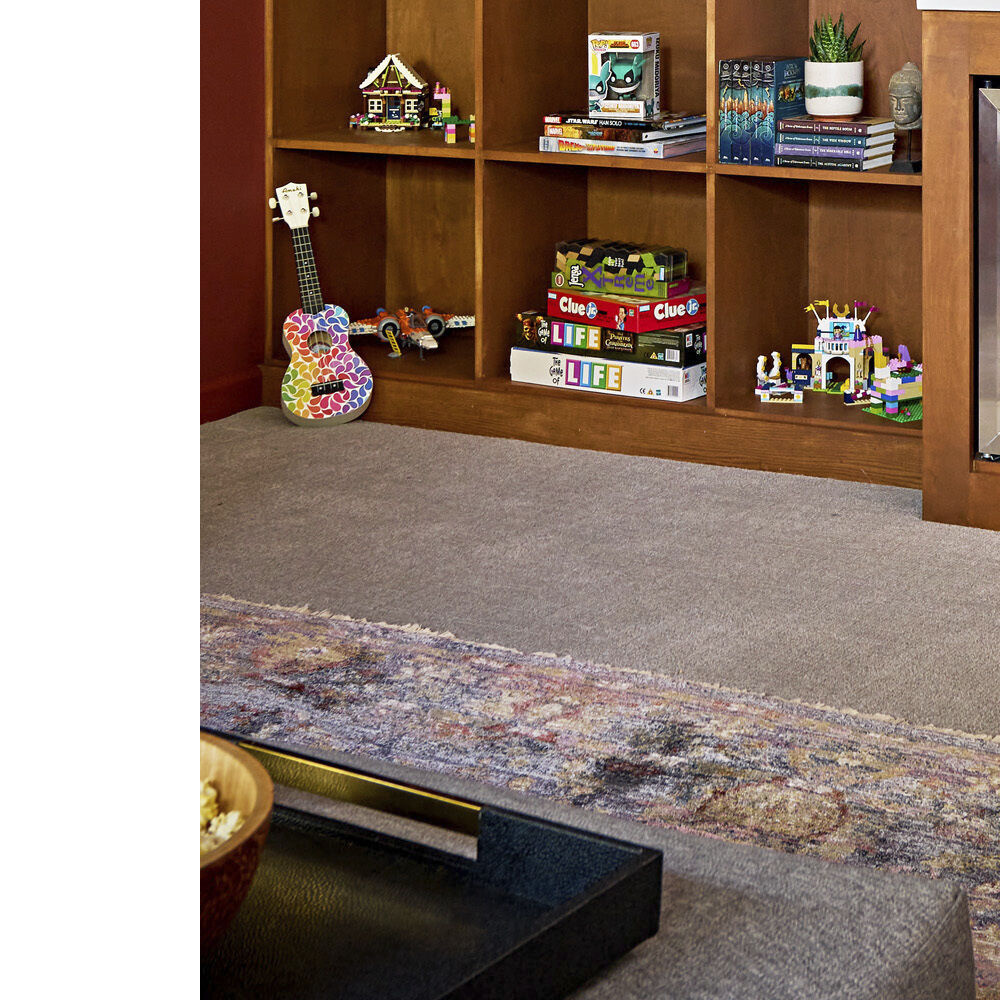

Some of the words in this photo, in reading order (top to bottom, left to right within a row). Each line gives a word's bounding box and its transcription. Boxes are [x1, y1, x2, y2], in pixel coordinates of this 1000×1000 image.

[569, 264, 585, 287] Jenga
[559, 296, 585, 315] Clue
[654, 303, 686, 320] Clue
[553, 324, 599, 348] LIFE
[568, 362, 620, 389] LIFE
